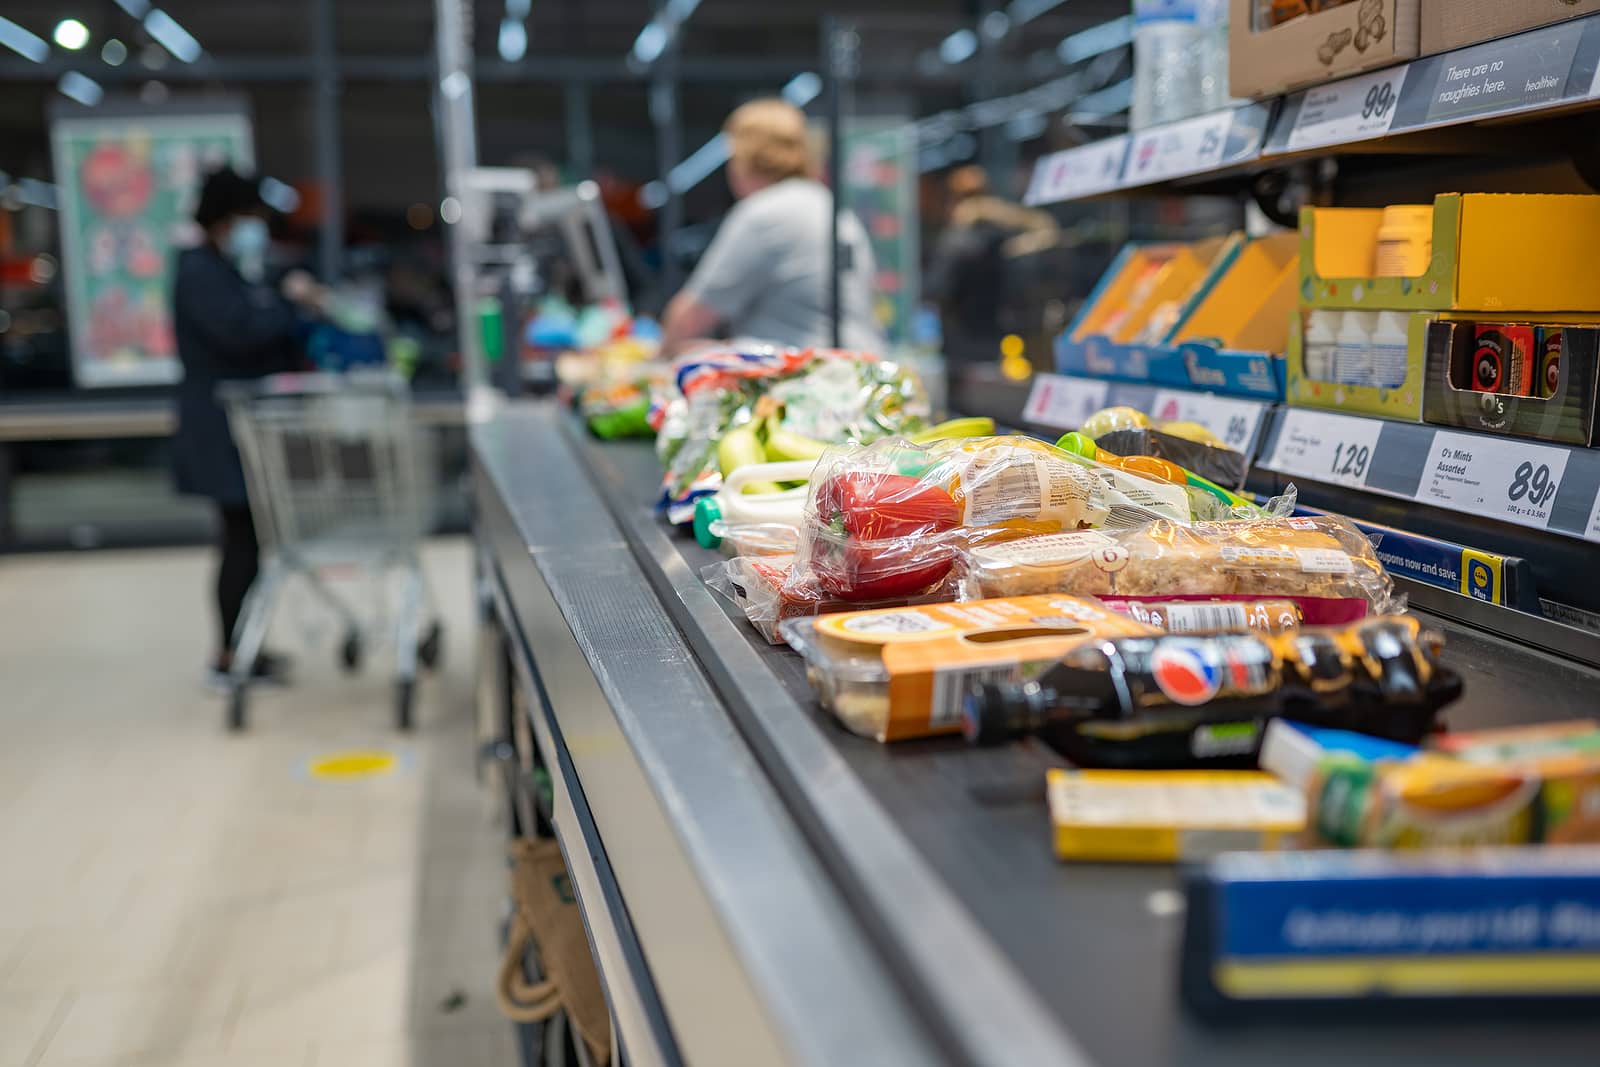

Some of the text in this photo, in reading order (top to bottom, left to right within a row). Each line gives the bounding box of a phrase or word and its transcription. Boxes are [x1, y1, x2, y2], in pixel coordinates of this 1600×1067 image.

[1446, 60, 1504, 82] There are no
[1482, 78, 1506, 94] here.
[1524, 76, 1559, 92] healthier
[1362, 82, 1396, 119] 99p
[1481, 393, 1504, 414] O's
[1331, 442, 1369, 478] 1.29
[1441, 448, 1473, 462] O's Mints
[1437, 461, 1467, 475] Assorted
[1508, 461, 1556, 508] 89p
[1405, 558, 1421, 572] now
[1422, 561, 1438, 576] and
[1438, 567, 1457, 582] save
